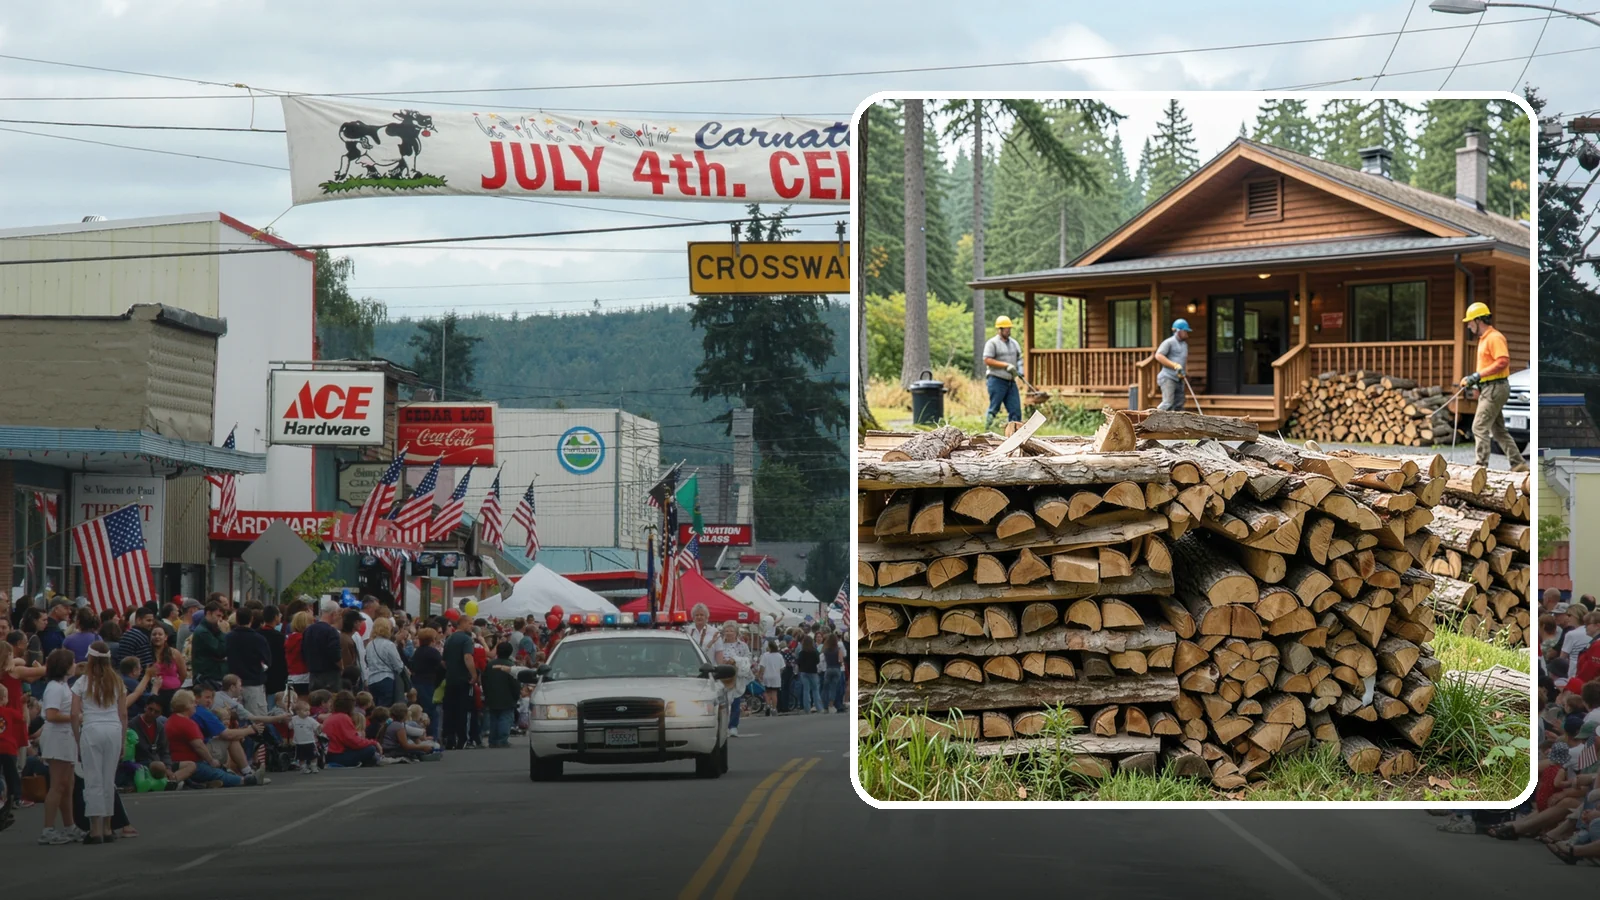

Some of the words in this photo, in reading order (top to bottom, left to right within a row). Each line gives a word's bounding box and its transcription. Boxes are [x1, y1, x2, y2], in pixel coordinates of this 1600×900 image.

[694, 121, 849, 150] Carnat
[481, 141, 605, 192] JULY
[632, 150, 747, 198] 4th.
[697, 254, 850, 280] CROSSWA
[282, 380, 373, 420] ACE
[405, 409, 452, 422] CEDAR
[283, 421, 371, 436] Hardware
[416, 428, 477, 447] Coca-Cola
[82, 485, 94, 494] St.
[95, 485, 124, 494] Vincent
[126, 486, 135, 494] de
[137, 486, 155, 495] Paul
[699, 535, 730, 543] GLASS
